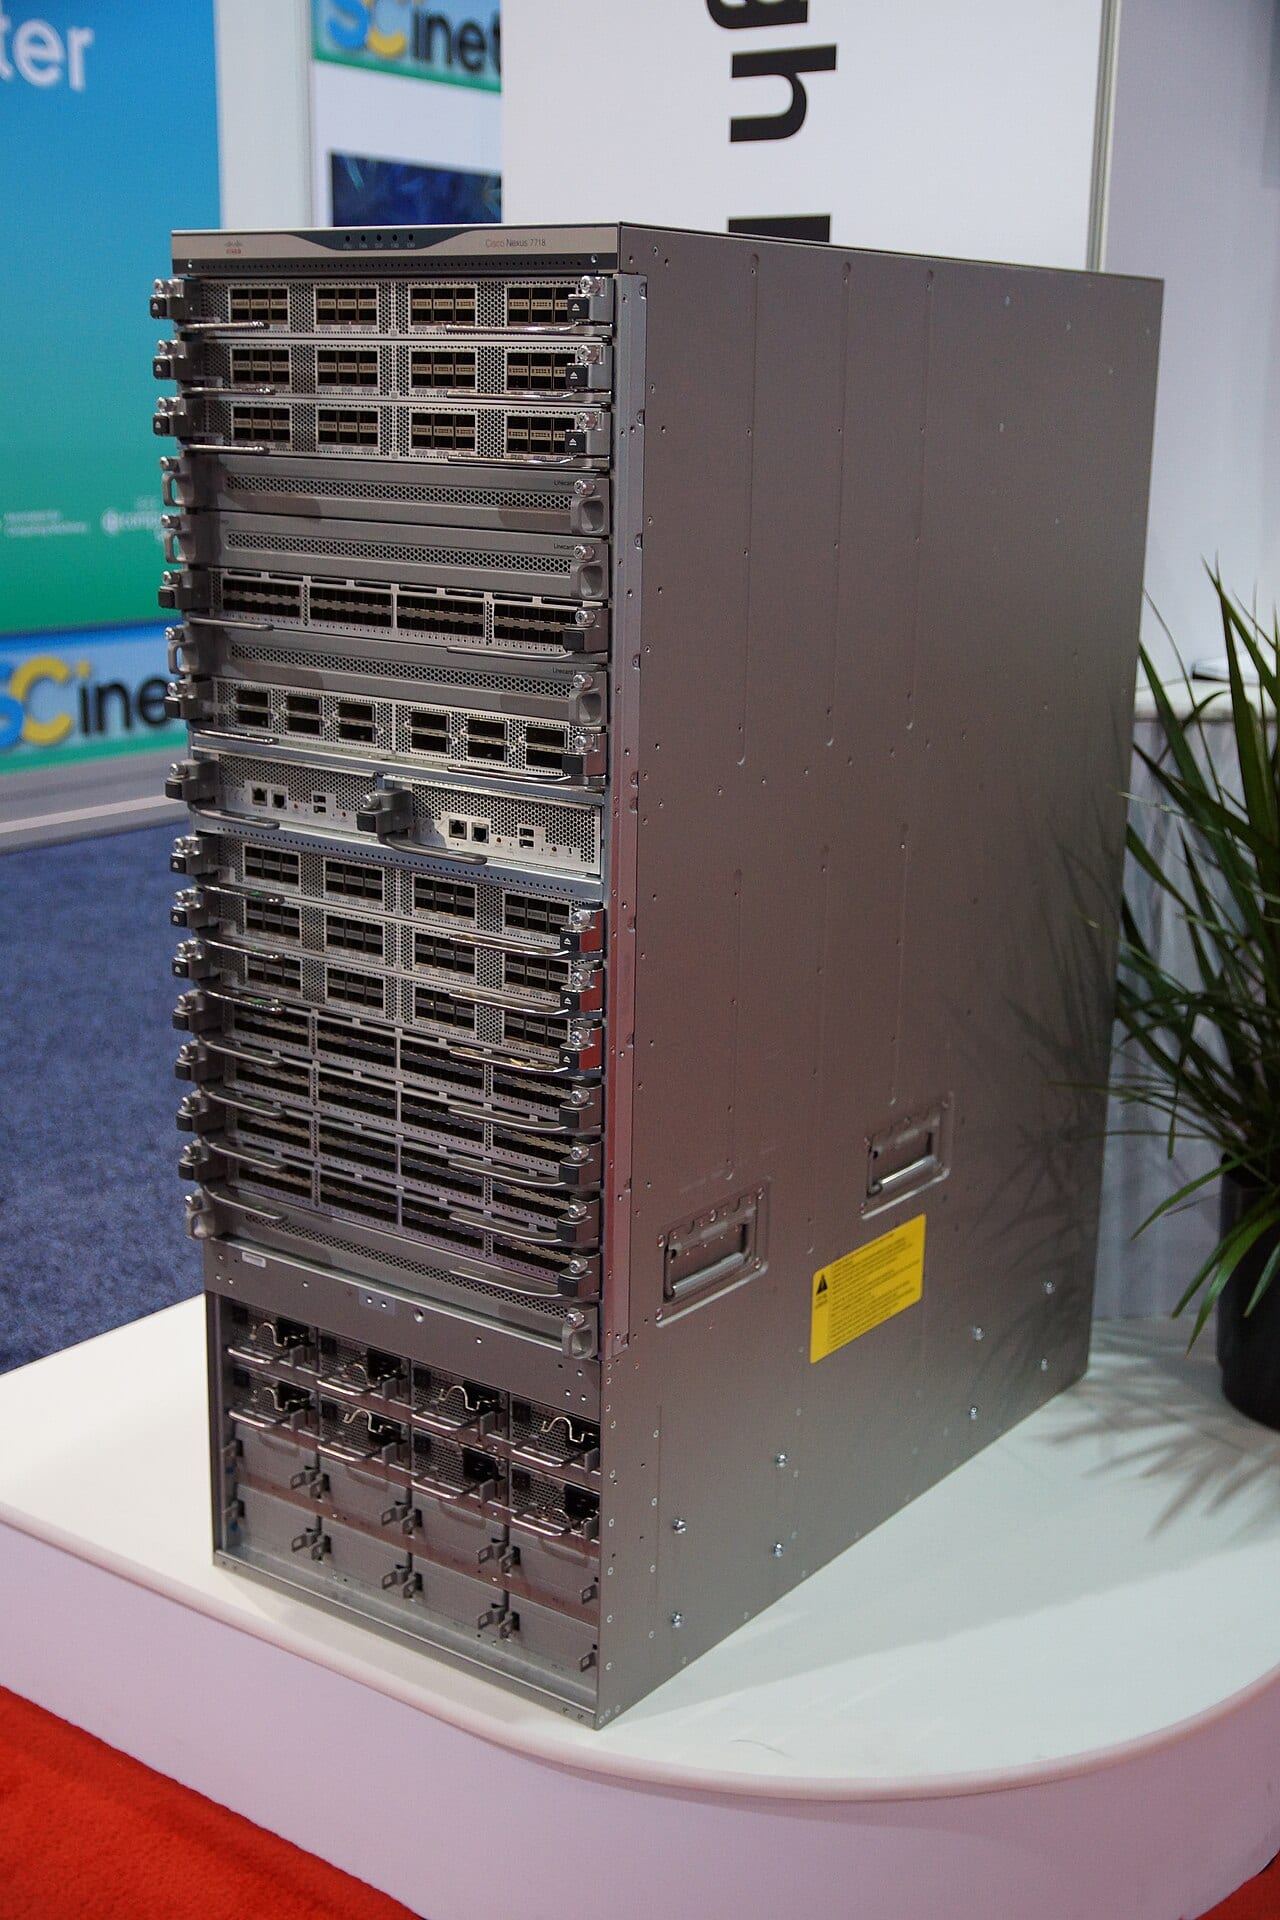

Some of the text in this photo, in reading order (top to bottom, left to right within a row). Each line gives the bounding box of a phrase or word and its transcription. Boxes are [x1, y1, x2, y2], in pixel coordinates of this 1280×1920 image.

[486, 238, 546, 248] Cisco Nexus 7718
